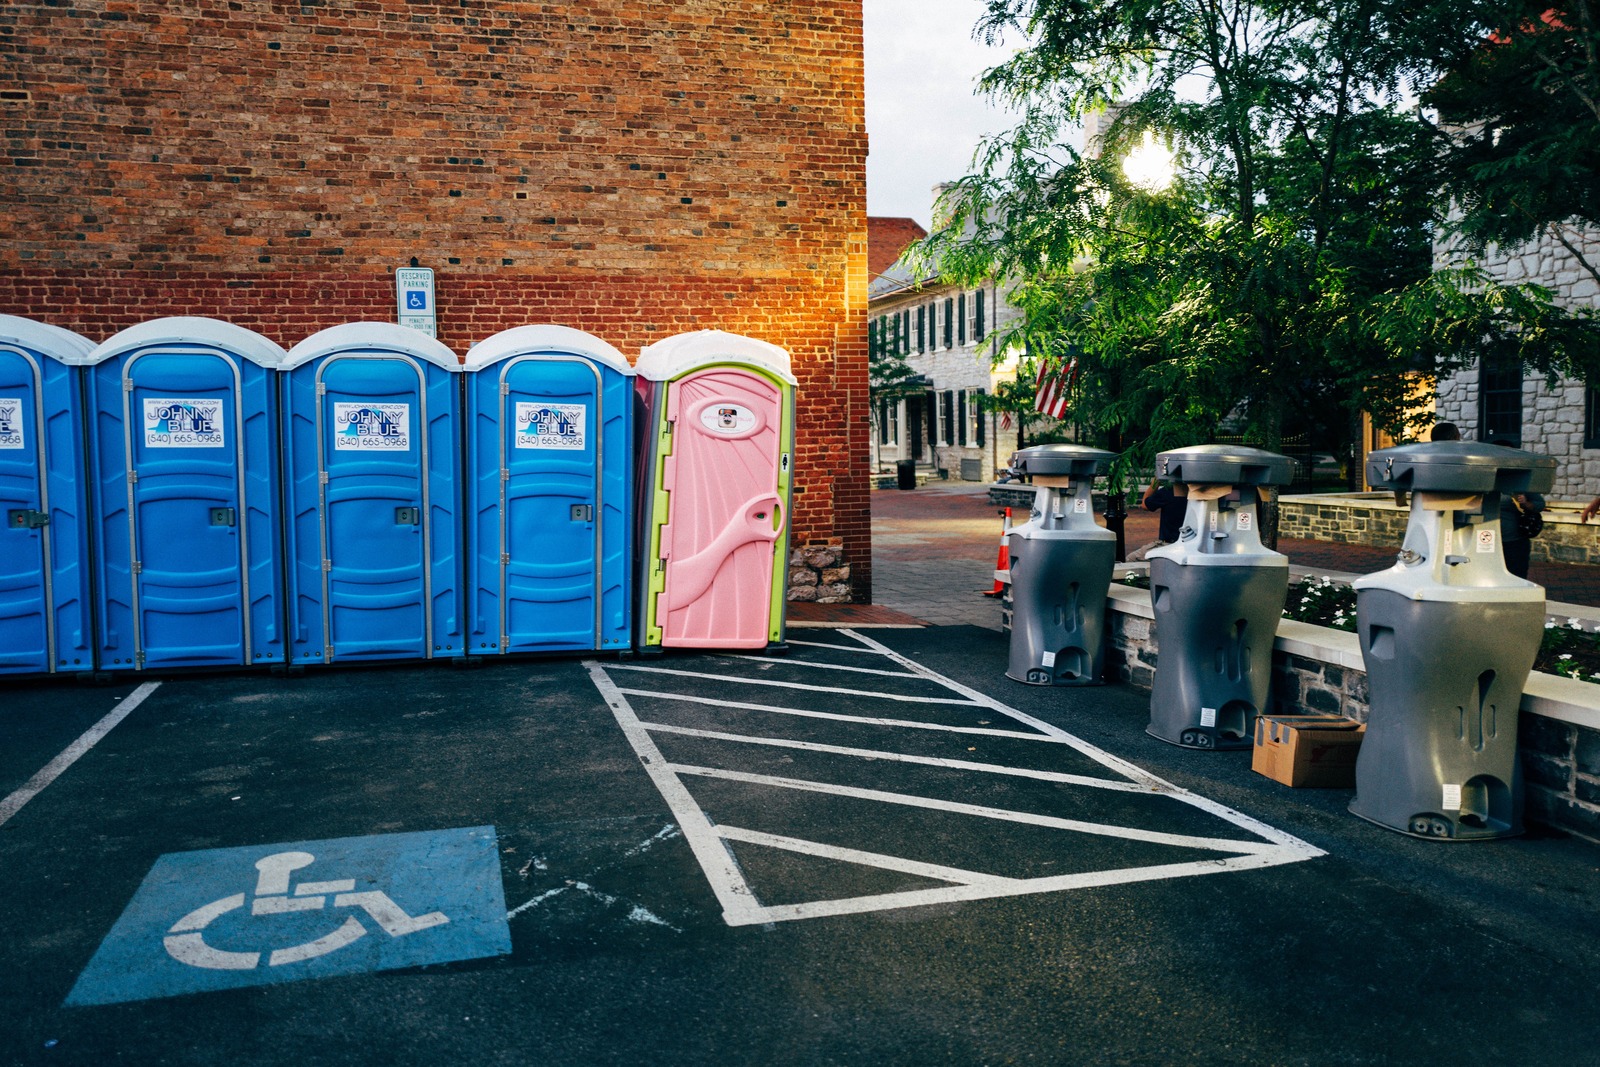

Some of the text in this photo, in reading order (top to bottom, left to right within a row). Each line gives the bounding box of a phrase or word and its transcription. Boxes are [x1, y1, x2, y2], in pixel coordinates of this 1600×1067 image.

[401, 272, 431, 280] RESERVED
[147, 406, 217, 420] JOHNNY
[338, 411, 403, 424] JOHNNY
[519, 410, 580, 424] JOHNNY
[167, 420, 213, 433] BLUE
[356, 423, 400, 436] BLUE
[536, 423, 577, 436] BLUE
[147, 434, 222, 444] (540) 665-0968
[337, 437, 407, 447] (540) 665-0968
[517, 436, 583, 446] (540) 665-0968
